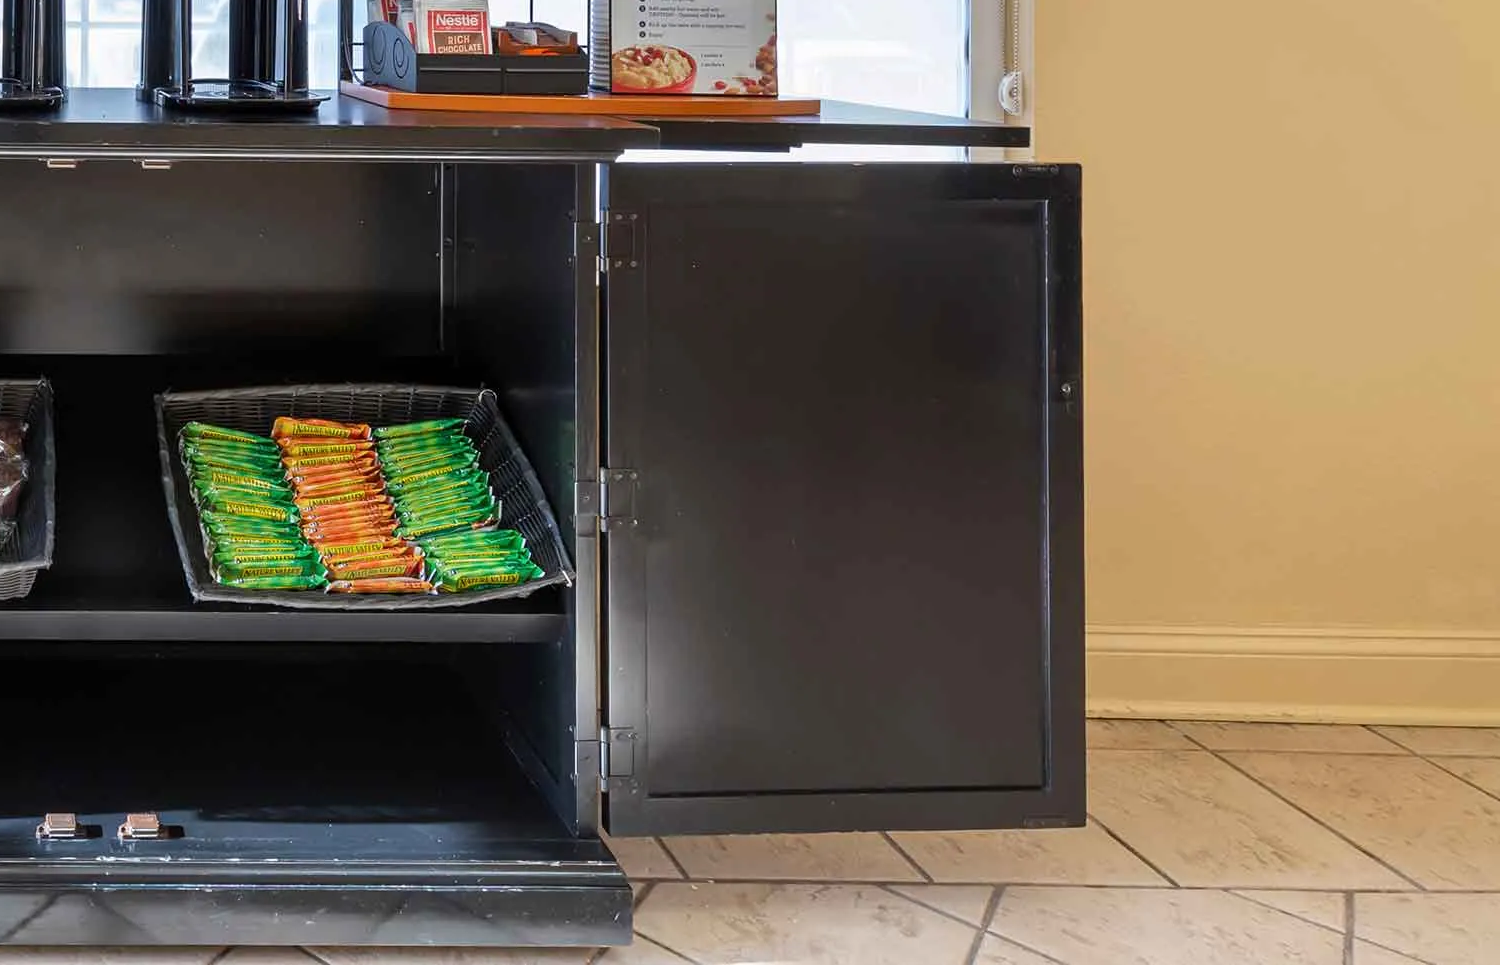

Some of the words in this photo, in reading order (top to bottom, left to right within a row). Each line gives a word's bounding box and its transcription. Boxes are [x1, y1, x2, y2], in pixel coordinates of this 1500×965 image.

[447, 35, 470, 45] RICH
[438, 44, 483, 54] CHOCOLATE
[460, 576, 490, 588] NATURE
[490, 574, 517, 584] VALLEY
